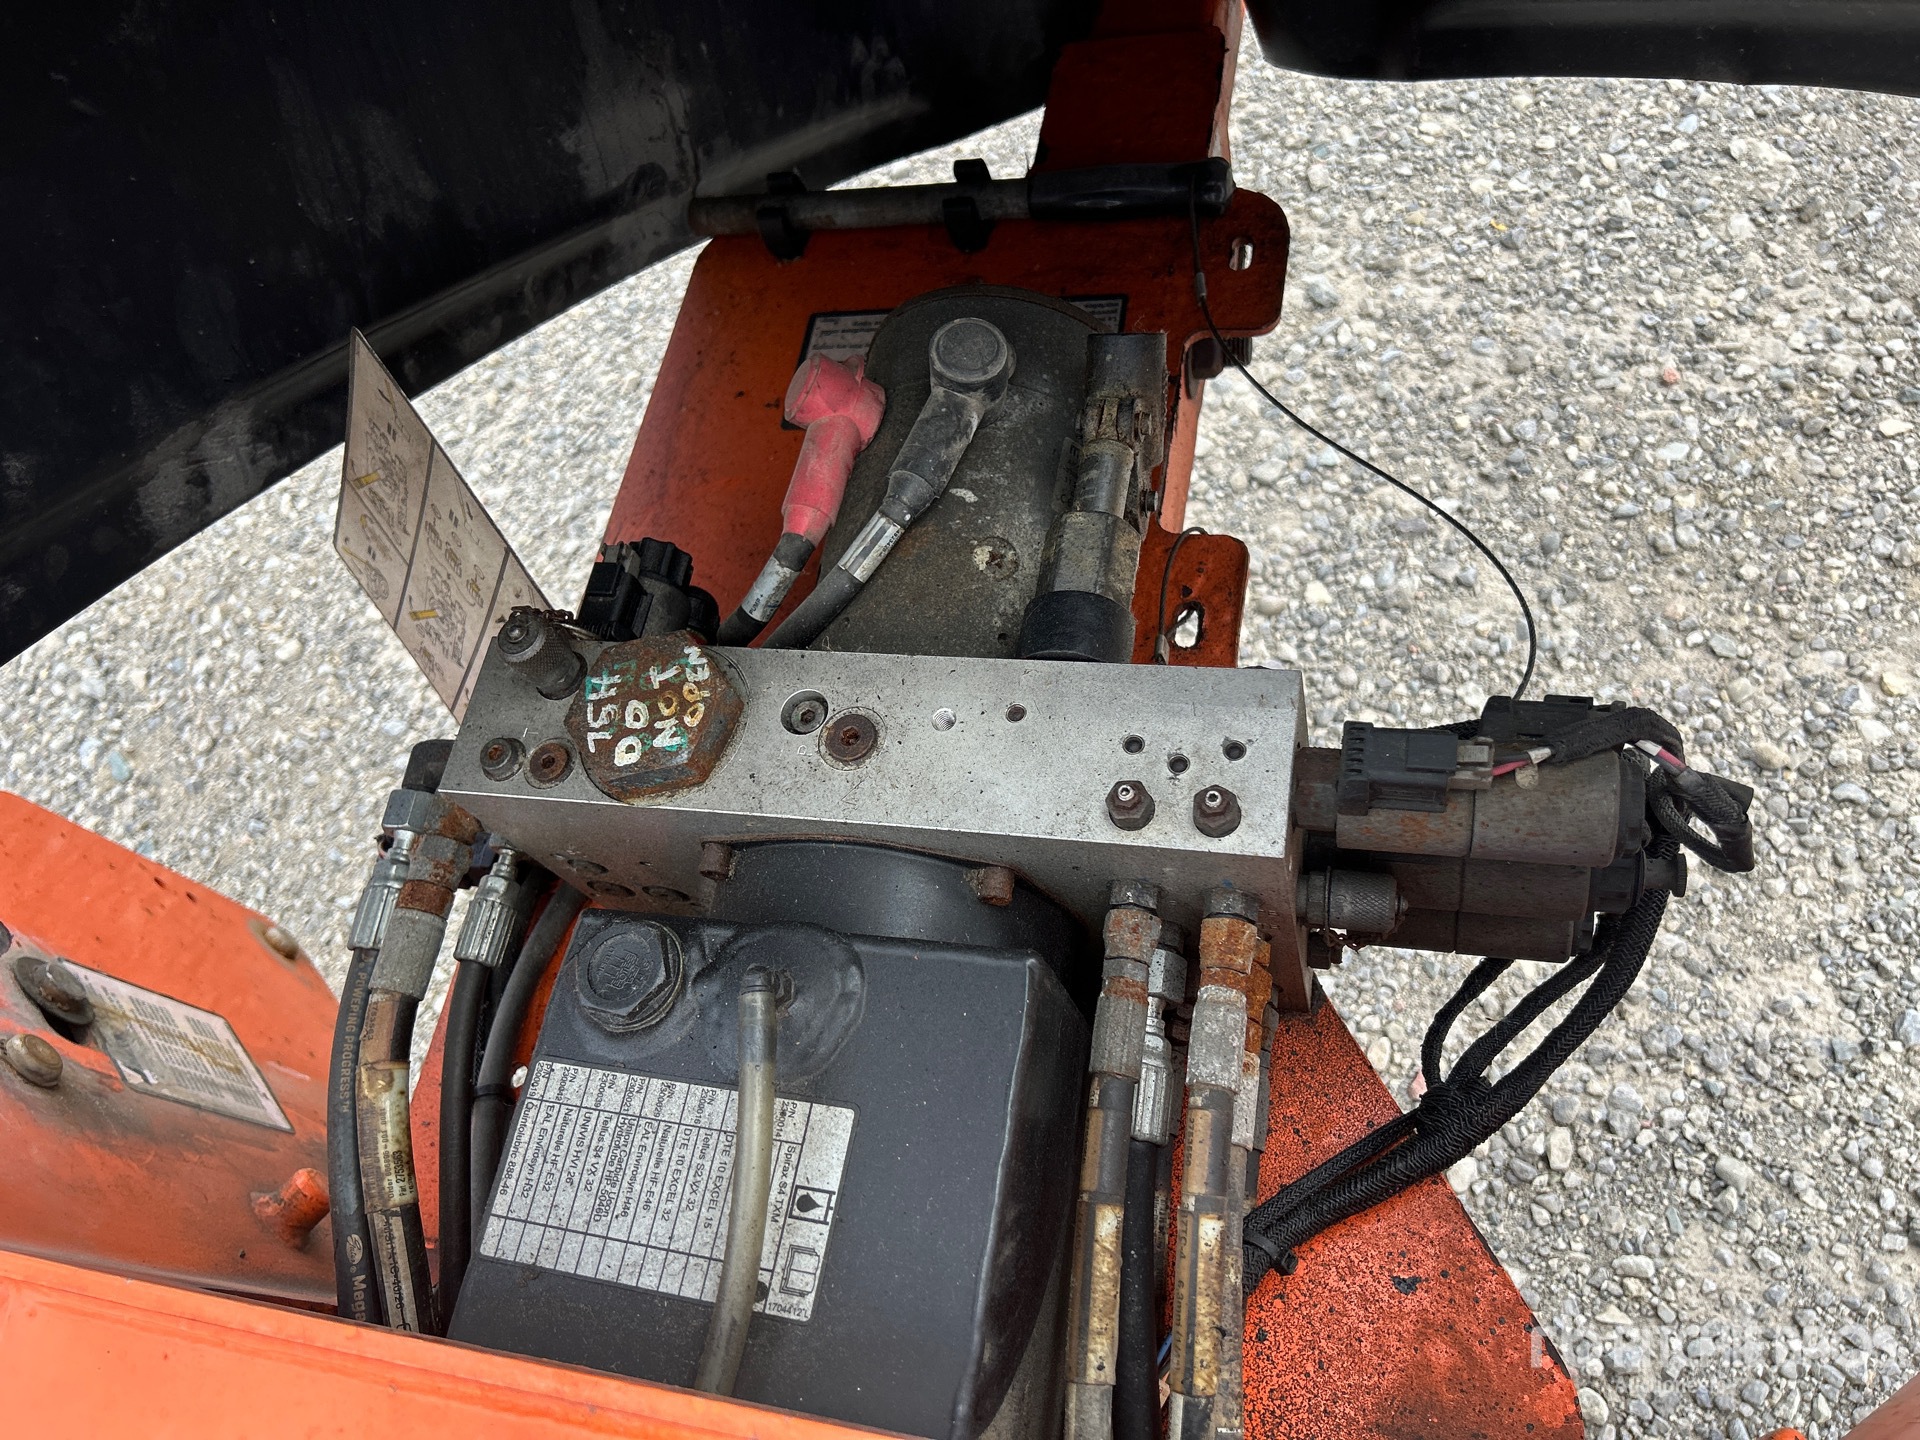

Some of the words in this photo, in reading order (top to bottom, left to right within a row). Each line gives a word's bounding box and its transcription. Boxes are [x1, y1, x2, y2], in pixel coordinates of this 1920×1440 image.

[747, 596, 762, 615] PUMP
[683, 646, 710, 727] OPEN
[649, 665, 682, 747] NOT
[614, 700, 649, 767] DO
[345, 972, 367, 1032] POWERING
[542, 1064, 551, 1078] P/N
[556, 1067, 570, 1100] 2300042
[569, 1068, 578, 1083] P/N
[607, 1074, 617, 1089] P/N
[594, 1073, 609, 1107] 2300039
[623, 1077, 638, 1111] 2300021
[635, 1078, 645, 1094] P/N
[666, 1084, 676, 1098] P/N
[707, 1090, 716, 1105] P/N
[542, 1105, 554, 1126] EAL
[694, 1088, 709, 1124] 2300016
[788, 1102, 797, 1118] P/N
[511, 1101, 535, 1158] Quintolubric
[554, 1108, 573, 1151] Naturelle
[577, 1111, 593, 1146] UNIVIS
[598, 1114, 612, 1142] Tellus
[640, 1121, 652, 1142] EAL
[679, 1128, 692, 1150] DTE
[527, 1128, 548, 1175] Envirosyn
[593, 1145, 604, 1159] S4
[607, 1117, 628, 1166] Hydrolube
[654, 1124, 672, 1168] Naturelle
[699, 1132, 713, 1159] Tellus
[721, 1134, 734, 1157] DTE
[392, 1149, 405, 1183] 2753563
[569, 1150, 582, 1169] HVI
[588, 1161, 599, 1177] VX
[611, 1149, 628, 1187] Carbide
[626, 1144, 646, 1193] Envirosyn
[675, 1153, 685, 1166] 10
[694, 1163, 705, 1177] S2
[717, 1161, 727, 1172] 10
[781, 1145, 796, 1177] Spirax
[500, 1161, 517, 1195] 888-46
[543, 1154, 560, 1191] HF-E32
[565, 1171, 576, 1184] 26
[386, 1178, 394, 1198] Order
[520, 1178, 533, 1199] H32
[583, 1179, 595, 1192] 32
[593, 1169, 614, 1222] HP-5046D
[643, 1172, 659, 1210] HF-E46
[666, 1169, 682, 1205] EXCEL
[708, 1176, 723, 1212] EXCEL
[777, 1181, 787, 1195] S4
[603, 1191, 616, 1217] Ucon
[620, 1196, 633, 1218] H46
[661, 1208, 671, 1222] 32
[686, 1198, 696, 1212] 32
[771, 1198, 783, 1223] TXM
[703, 1216, 713, 1229] 15
